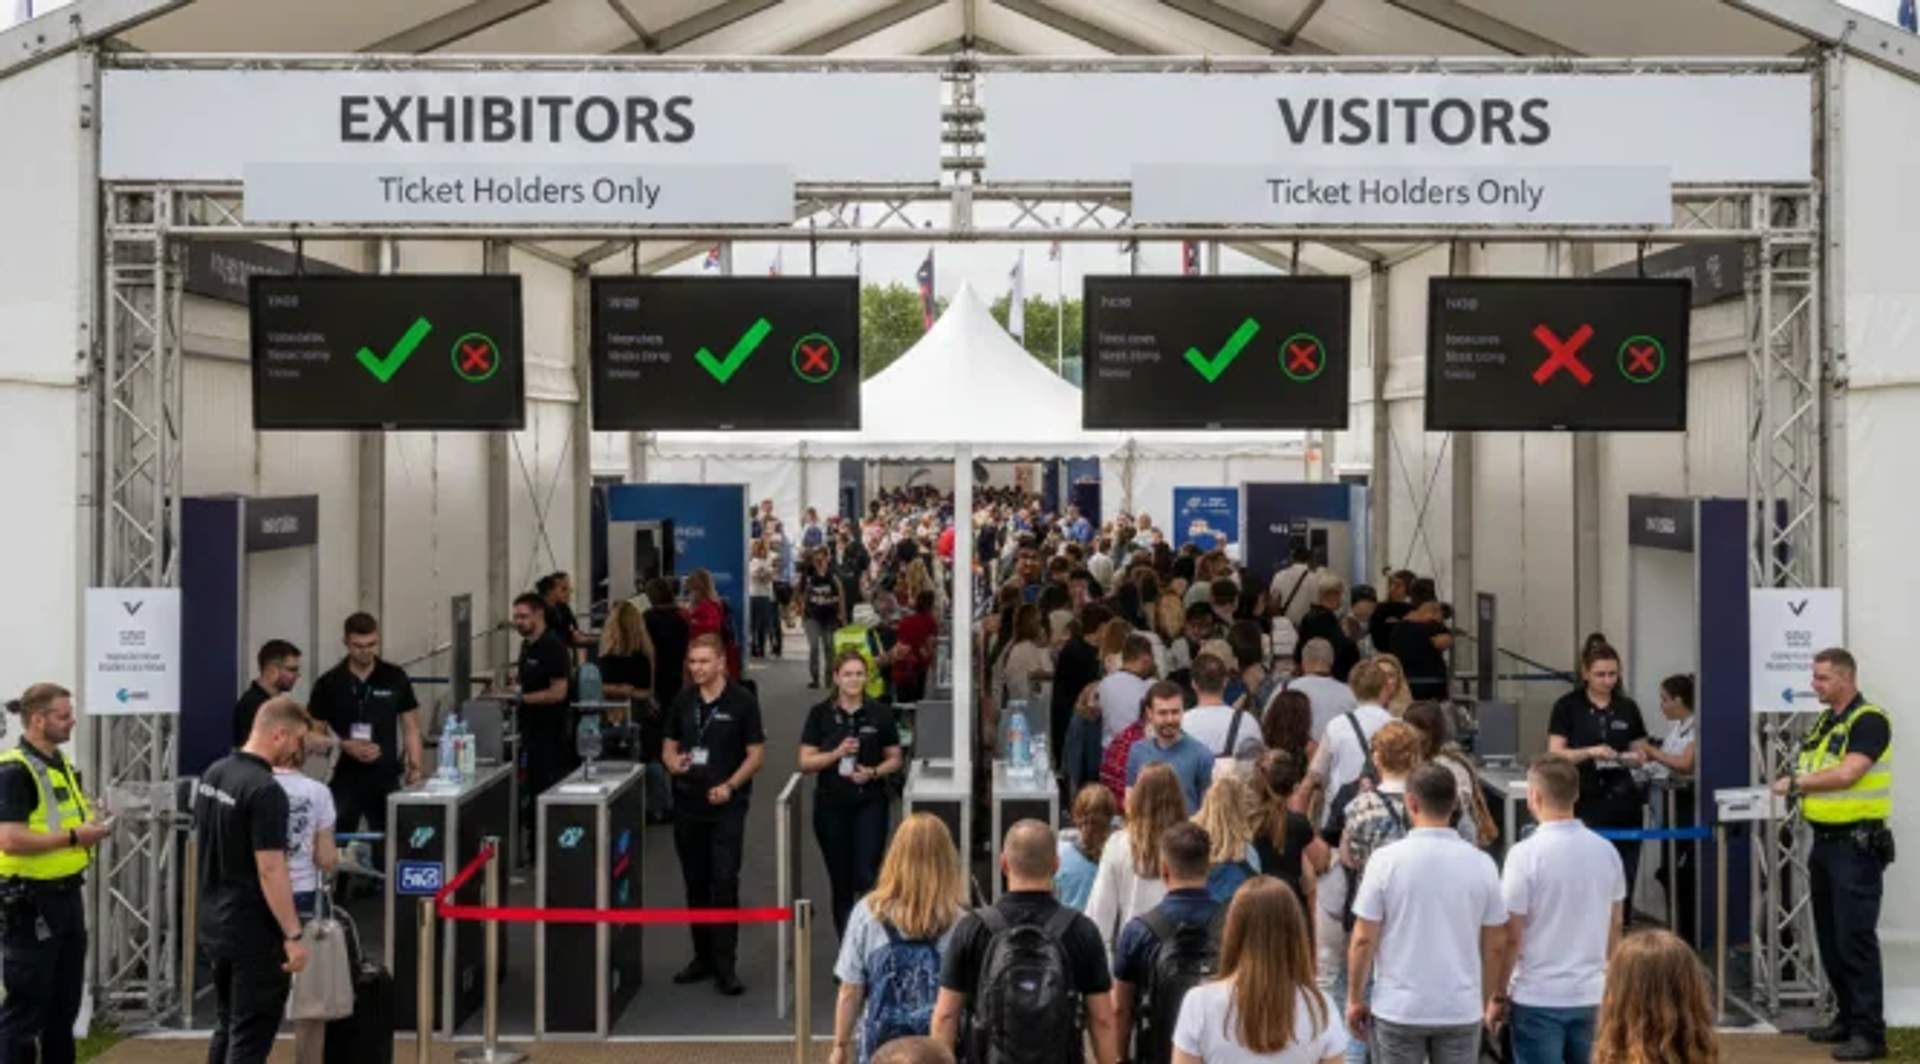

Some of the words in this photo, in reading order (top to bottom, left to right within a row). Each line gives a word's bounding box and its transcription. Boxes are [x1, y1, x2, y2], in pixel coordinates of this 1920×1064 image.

[339, 95, 696, 145] EXHIBITORS
[1277, 97, 1552, 146] VISITORS
[379, 176, 465, 204] Ticket
[473, 176, 585, 204] Holders
[592, 177, 662, 210] Only
[1266, 178, 1352, 205] Ticket
[1359, 176, 1471, 205] Holders
[1477, 178, 1544, 212] Only
